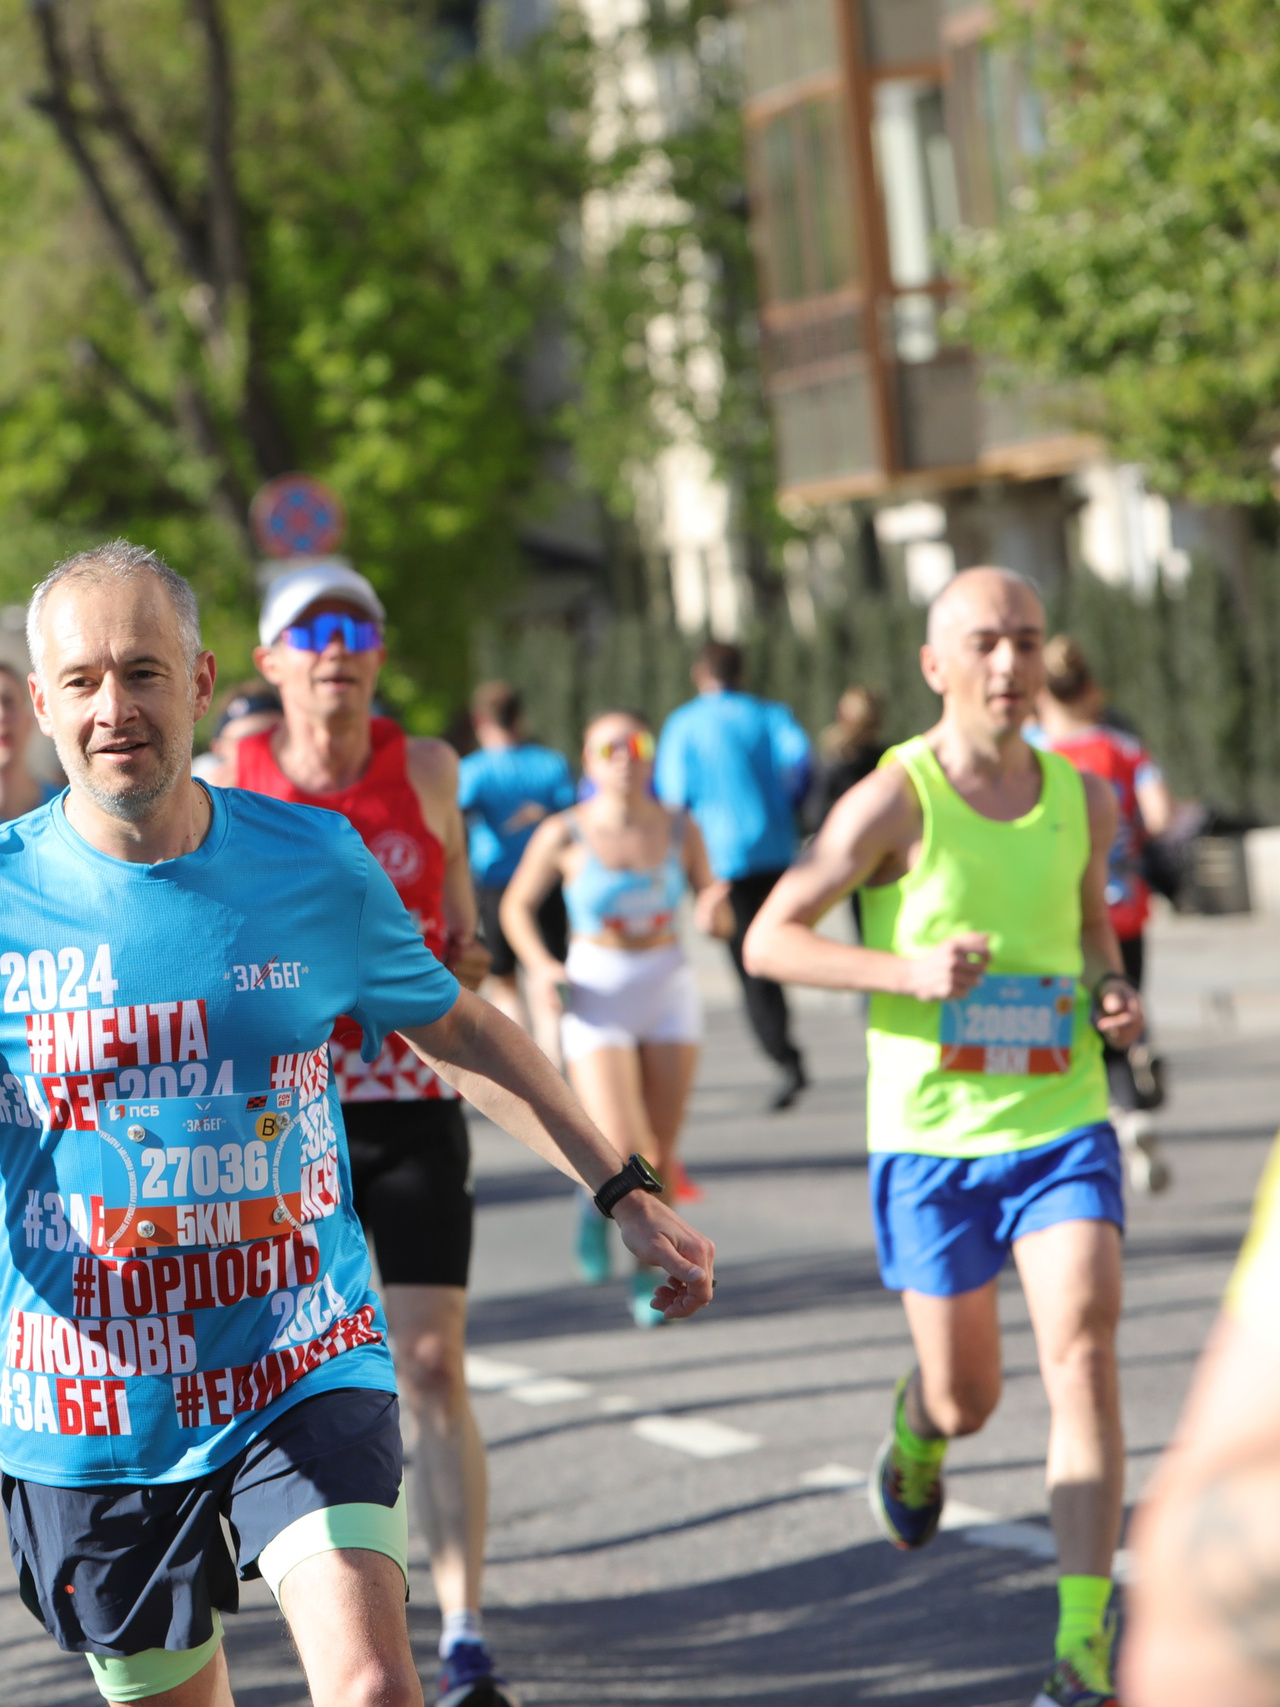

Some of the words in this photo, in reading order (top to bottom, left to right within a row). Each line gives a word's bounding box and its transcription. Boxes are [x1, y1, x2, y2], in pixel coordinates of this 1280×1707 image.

[0, 944, 118, 1013] 2024
[27, 999, 209, 1073] #МЕЧТА
[129, 1105, 160, 1118] ПСБ
[141, 1140, 269, 1199] 27036
[73, 1231, 320, 1318] #ГОРДОСТЬ
[5, 1307, 197, 1377] #ЛЮБОВЬ
[0, 1370, 131, 1436] #ЗАБЕГ
